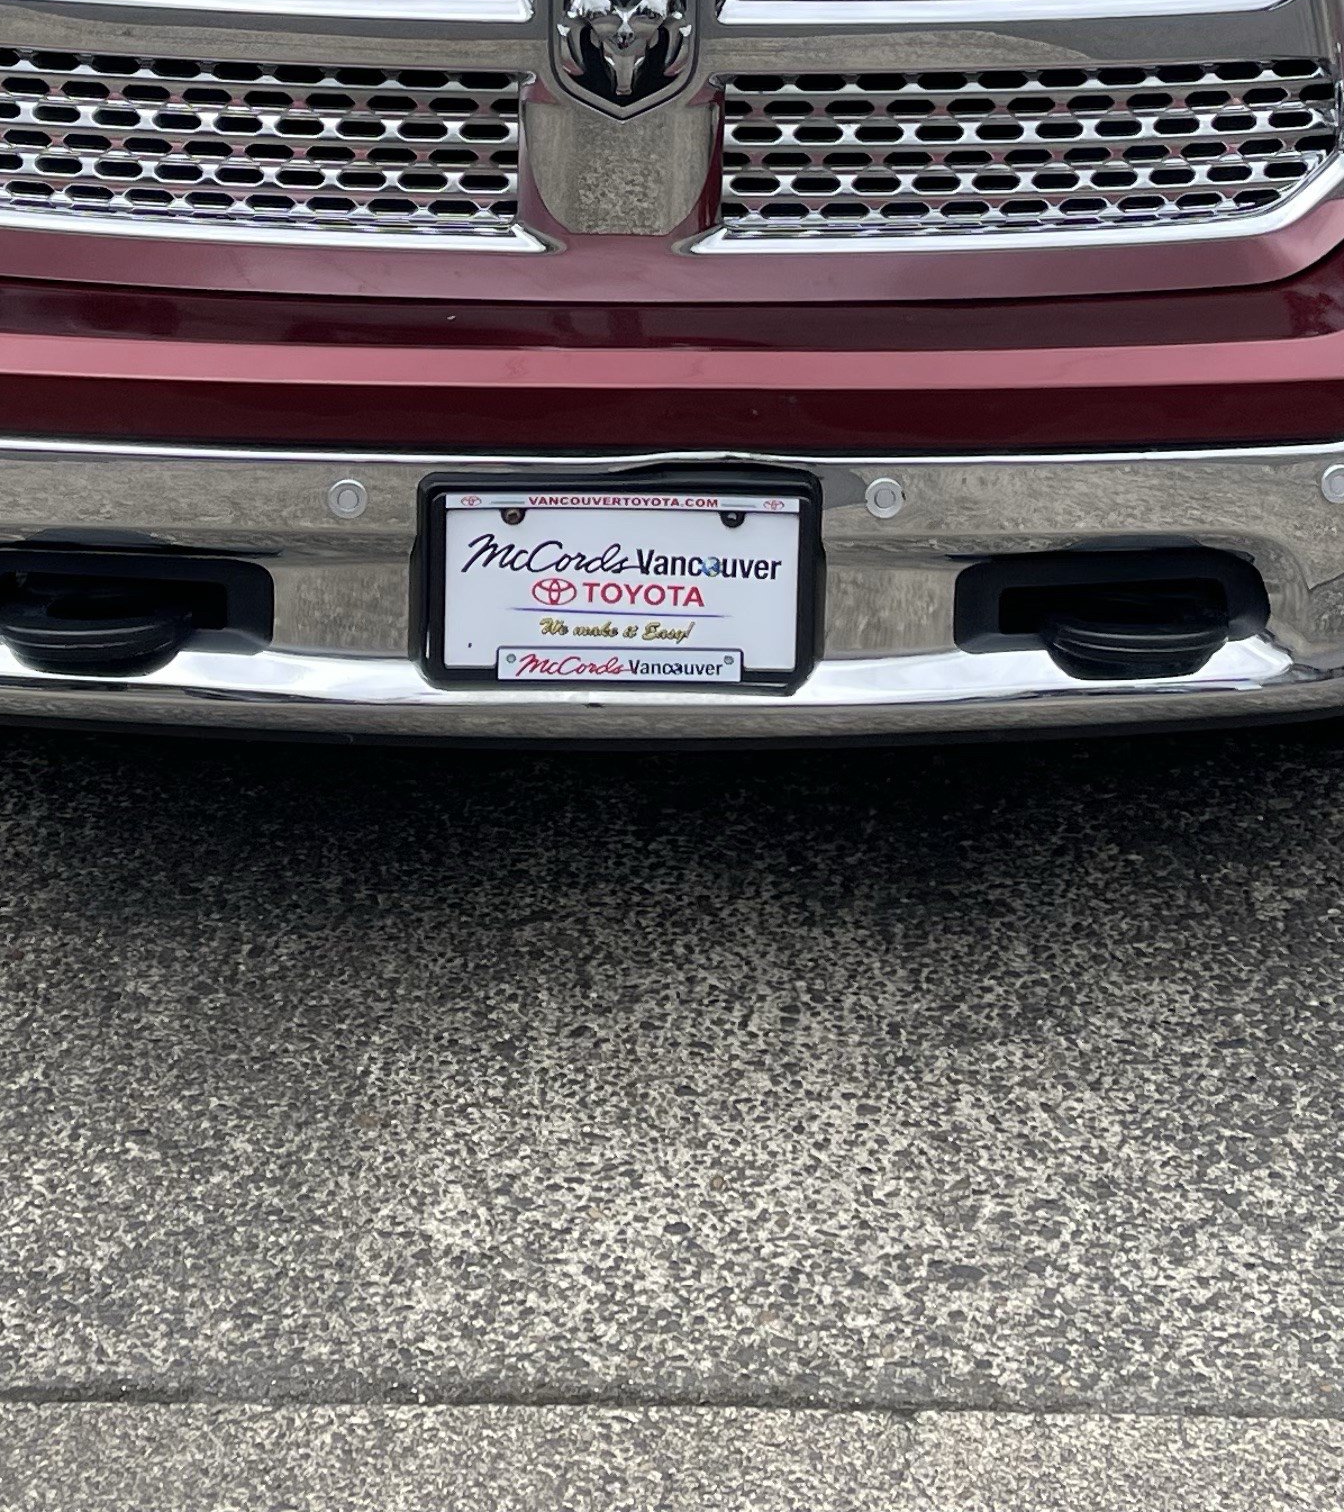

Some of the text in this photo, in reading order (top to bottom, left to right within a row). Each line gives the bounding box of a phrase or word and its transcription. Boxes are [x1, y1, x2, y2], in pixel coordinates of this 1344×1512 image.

[528, 496, 718, 509] VANCOUVERTOYOTA.COM
[582, 582, 705, 608] TOYOTA
[539, 617, 569, 635] We
[573, 621, 618, 637] make
[641, 621, 695, 644] Easy!
